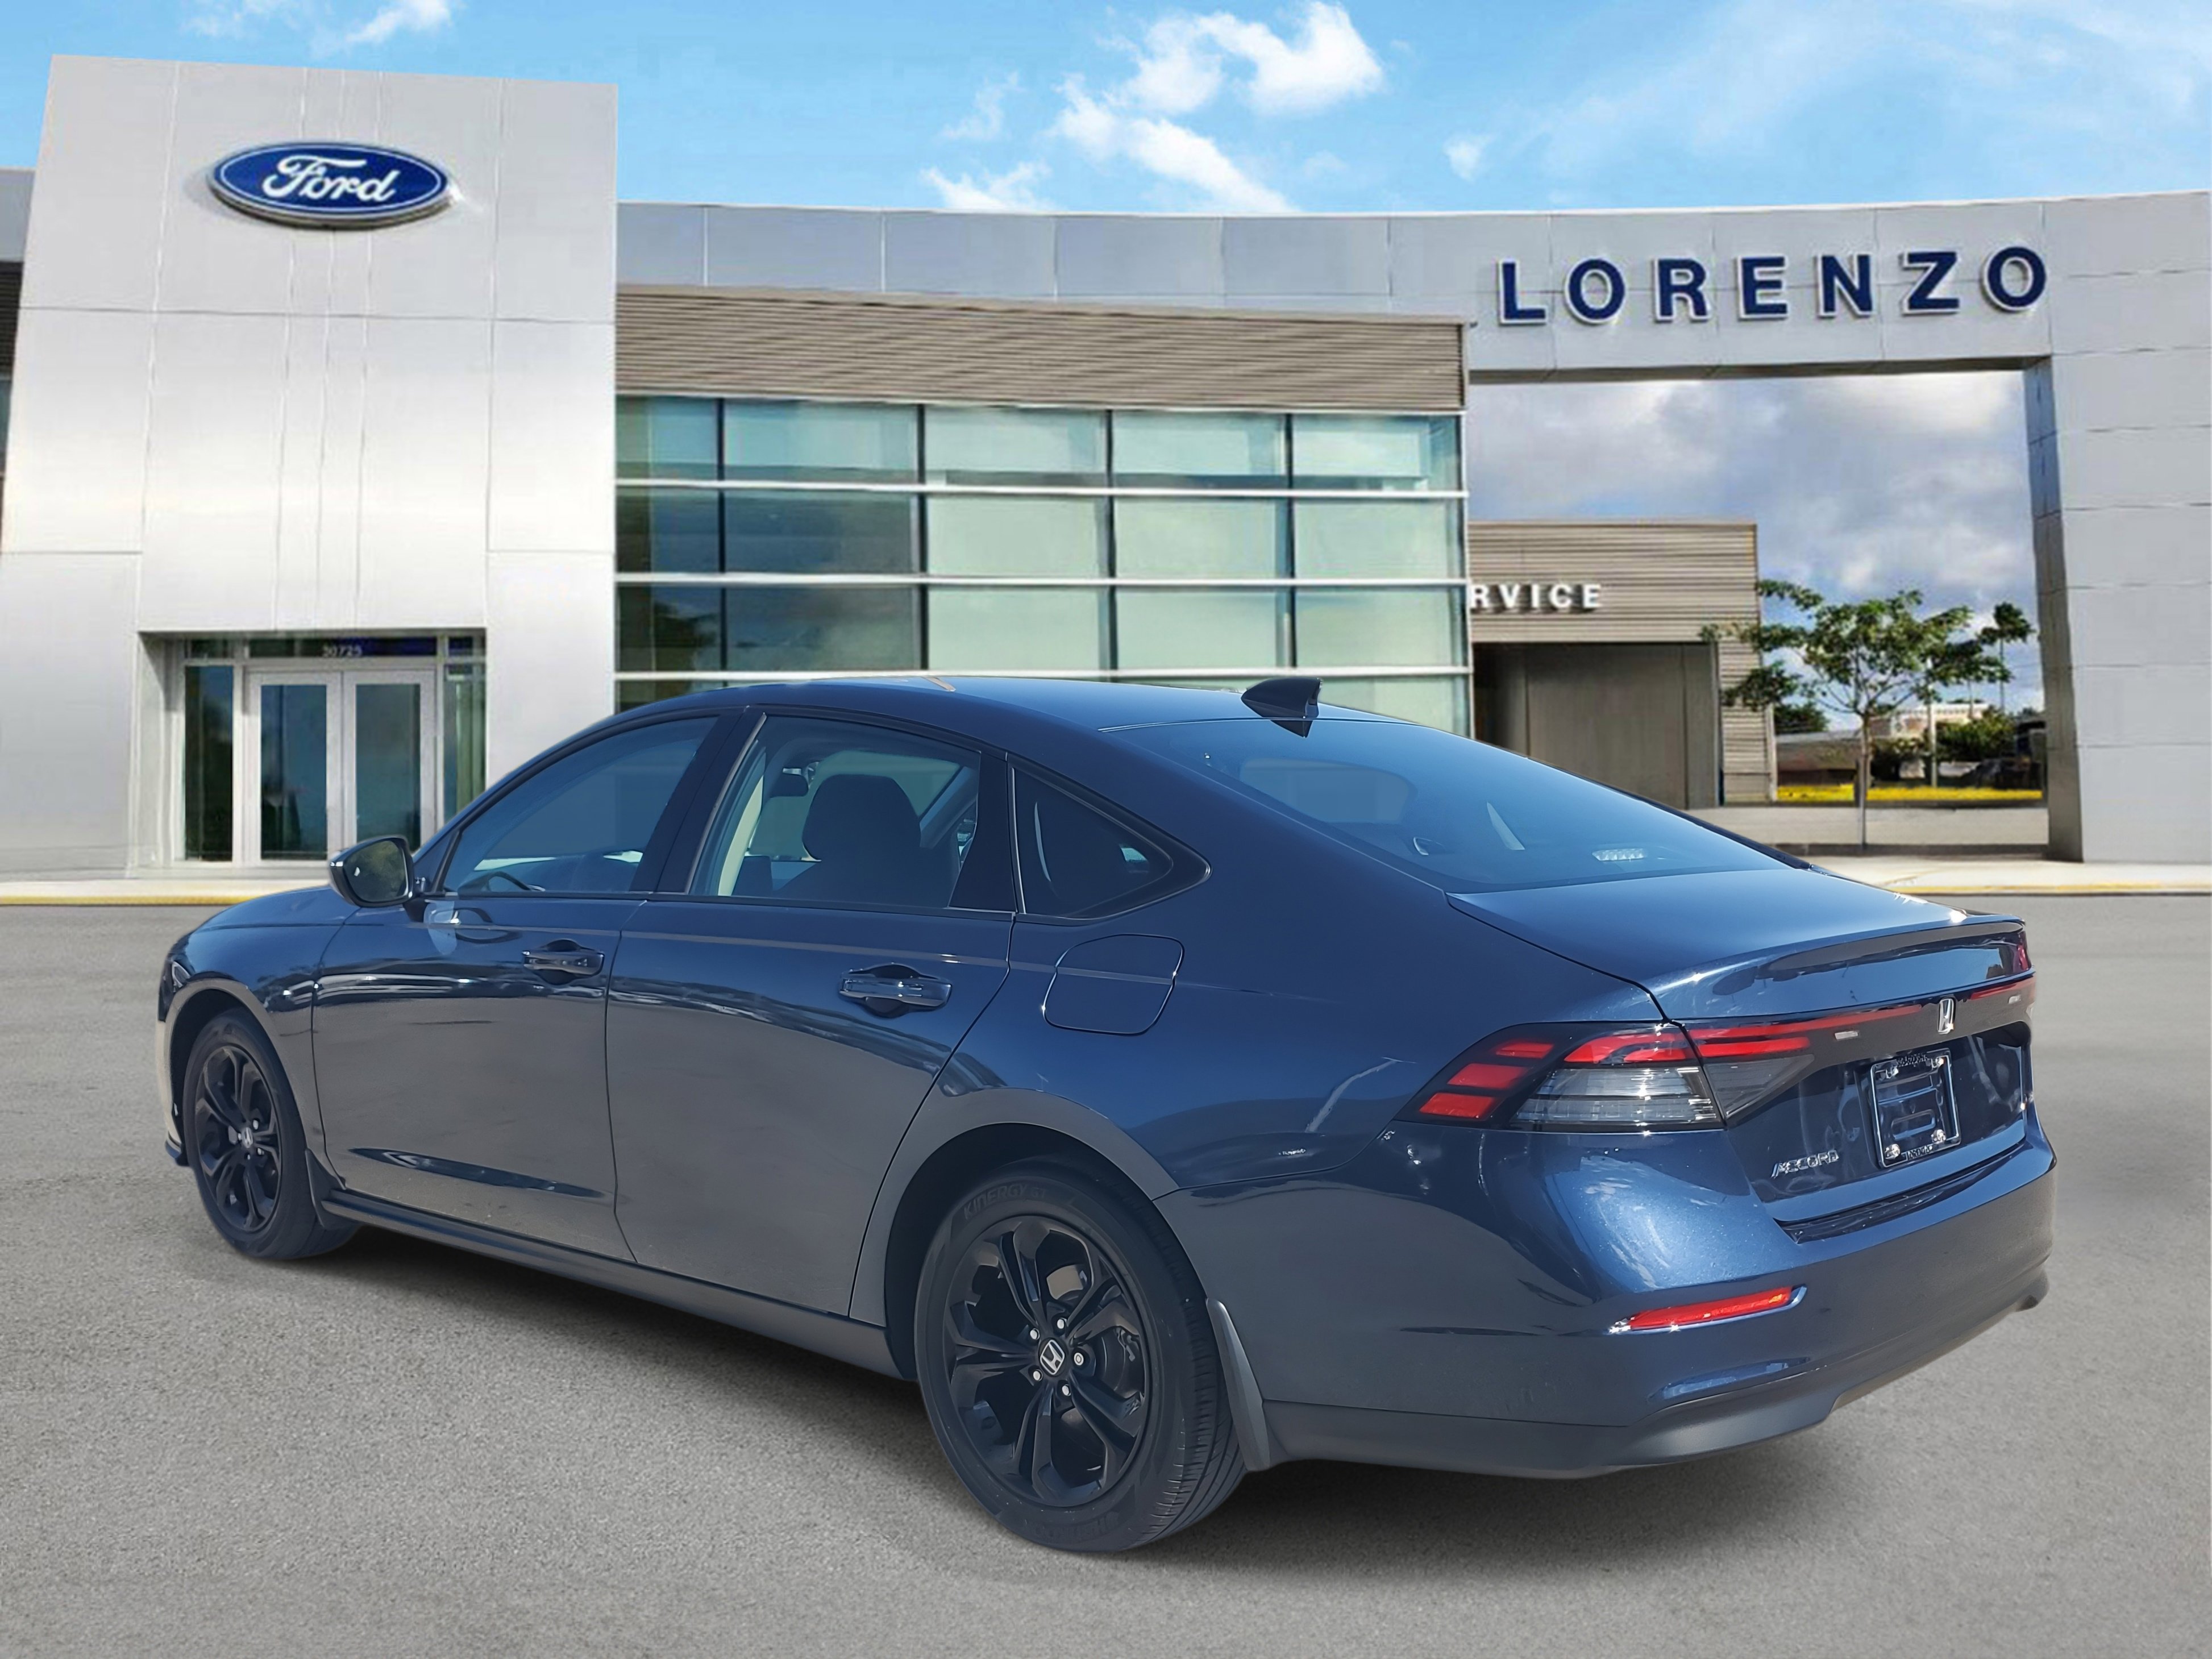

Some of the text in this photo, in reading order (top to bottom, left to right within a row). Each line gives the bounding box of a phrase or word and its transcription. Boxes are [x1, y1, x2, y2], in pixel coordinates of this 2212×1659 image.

[262, 154, 400, 202] Ford
[1497, 247, 2046, 324] LORENZO
[1771, 1150, 1840, 1178] ACCORD
